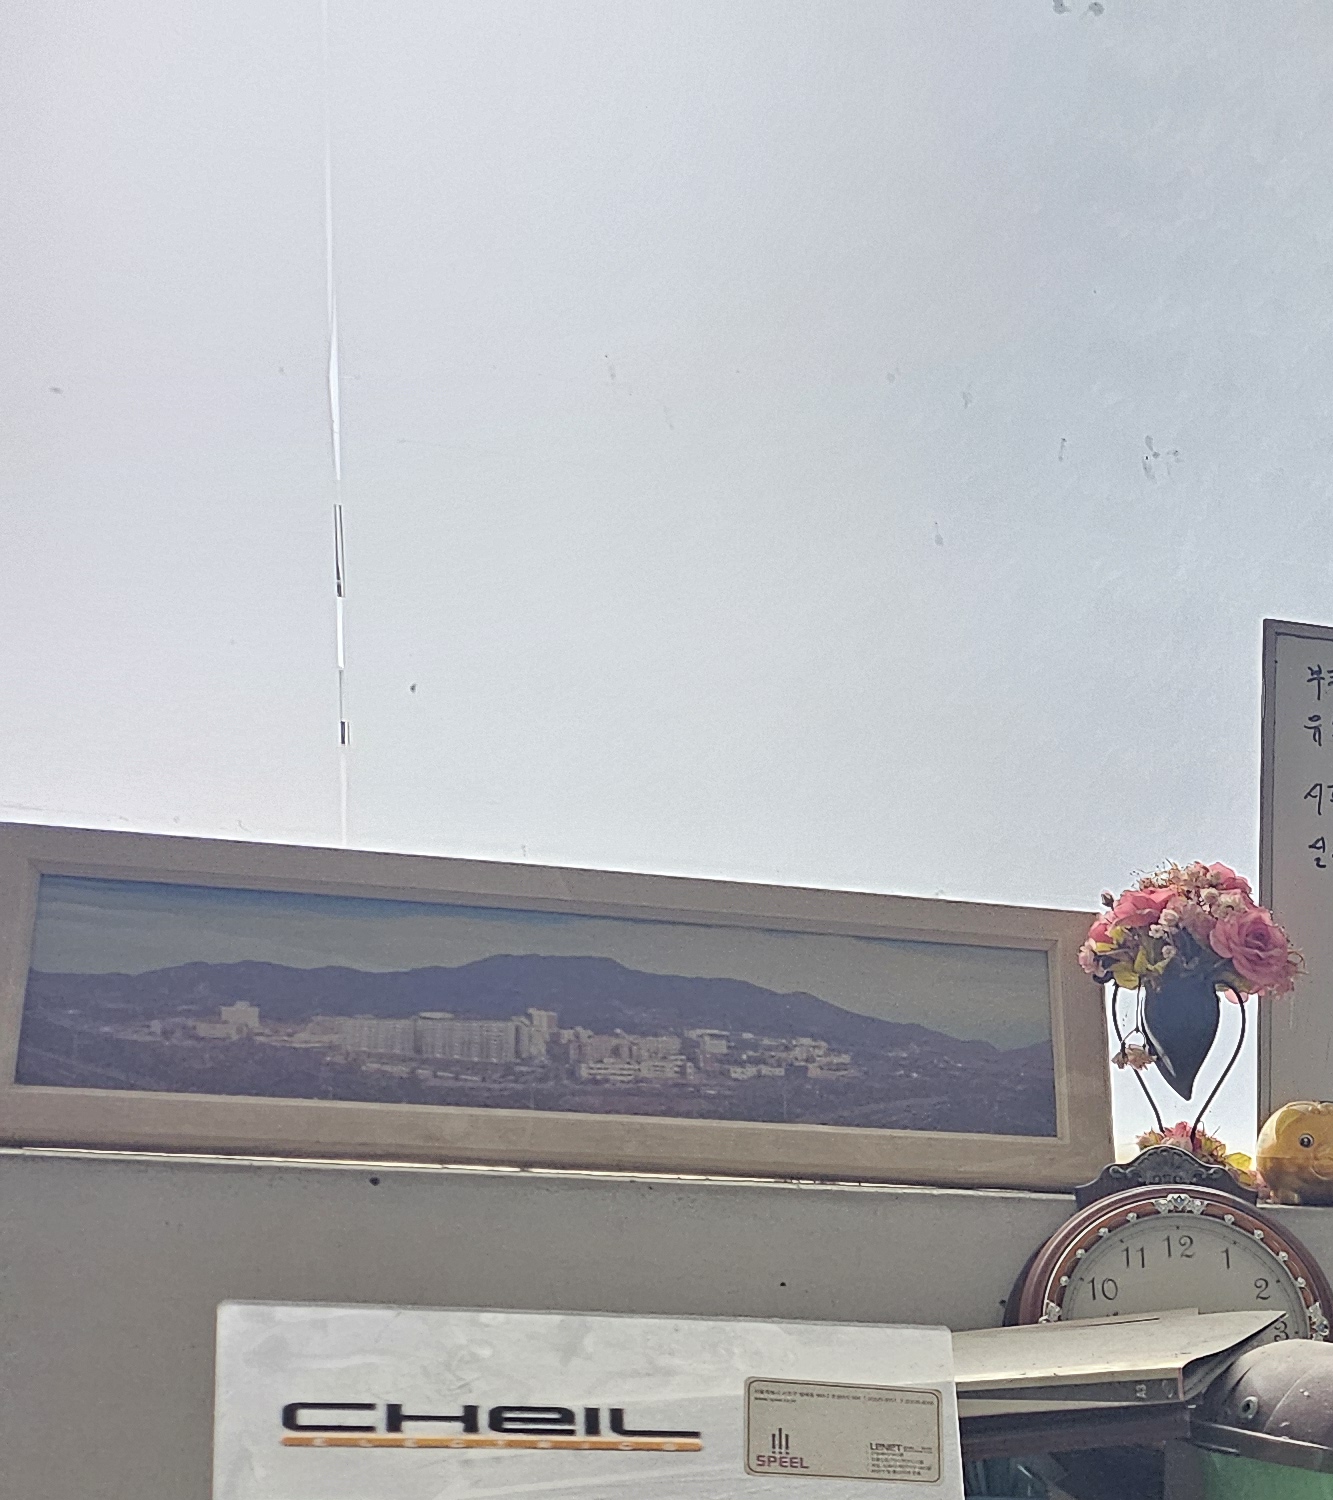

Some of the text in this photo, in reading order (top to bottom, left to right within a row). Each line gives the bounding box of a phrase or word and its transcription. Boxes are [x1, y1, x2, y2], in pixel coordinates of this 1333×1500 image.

[1088, 1276, 1120, 1302] 10
[1120, 1246, 1147, 1270] 11
[1162, 1234, 1196, 1260] 12
[1221, 1247, 1232, 1270] 1
[1254, 1277, 1270, 1301] 2
[755, 1453, 811, 1470] SPEEL
